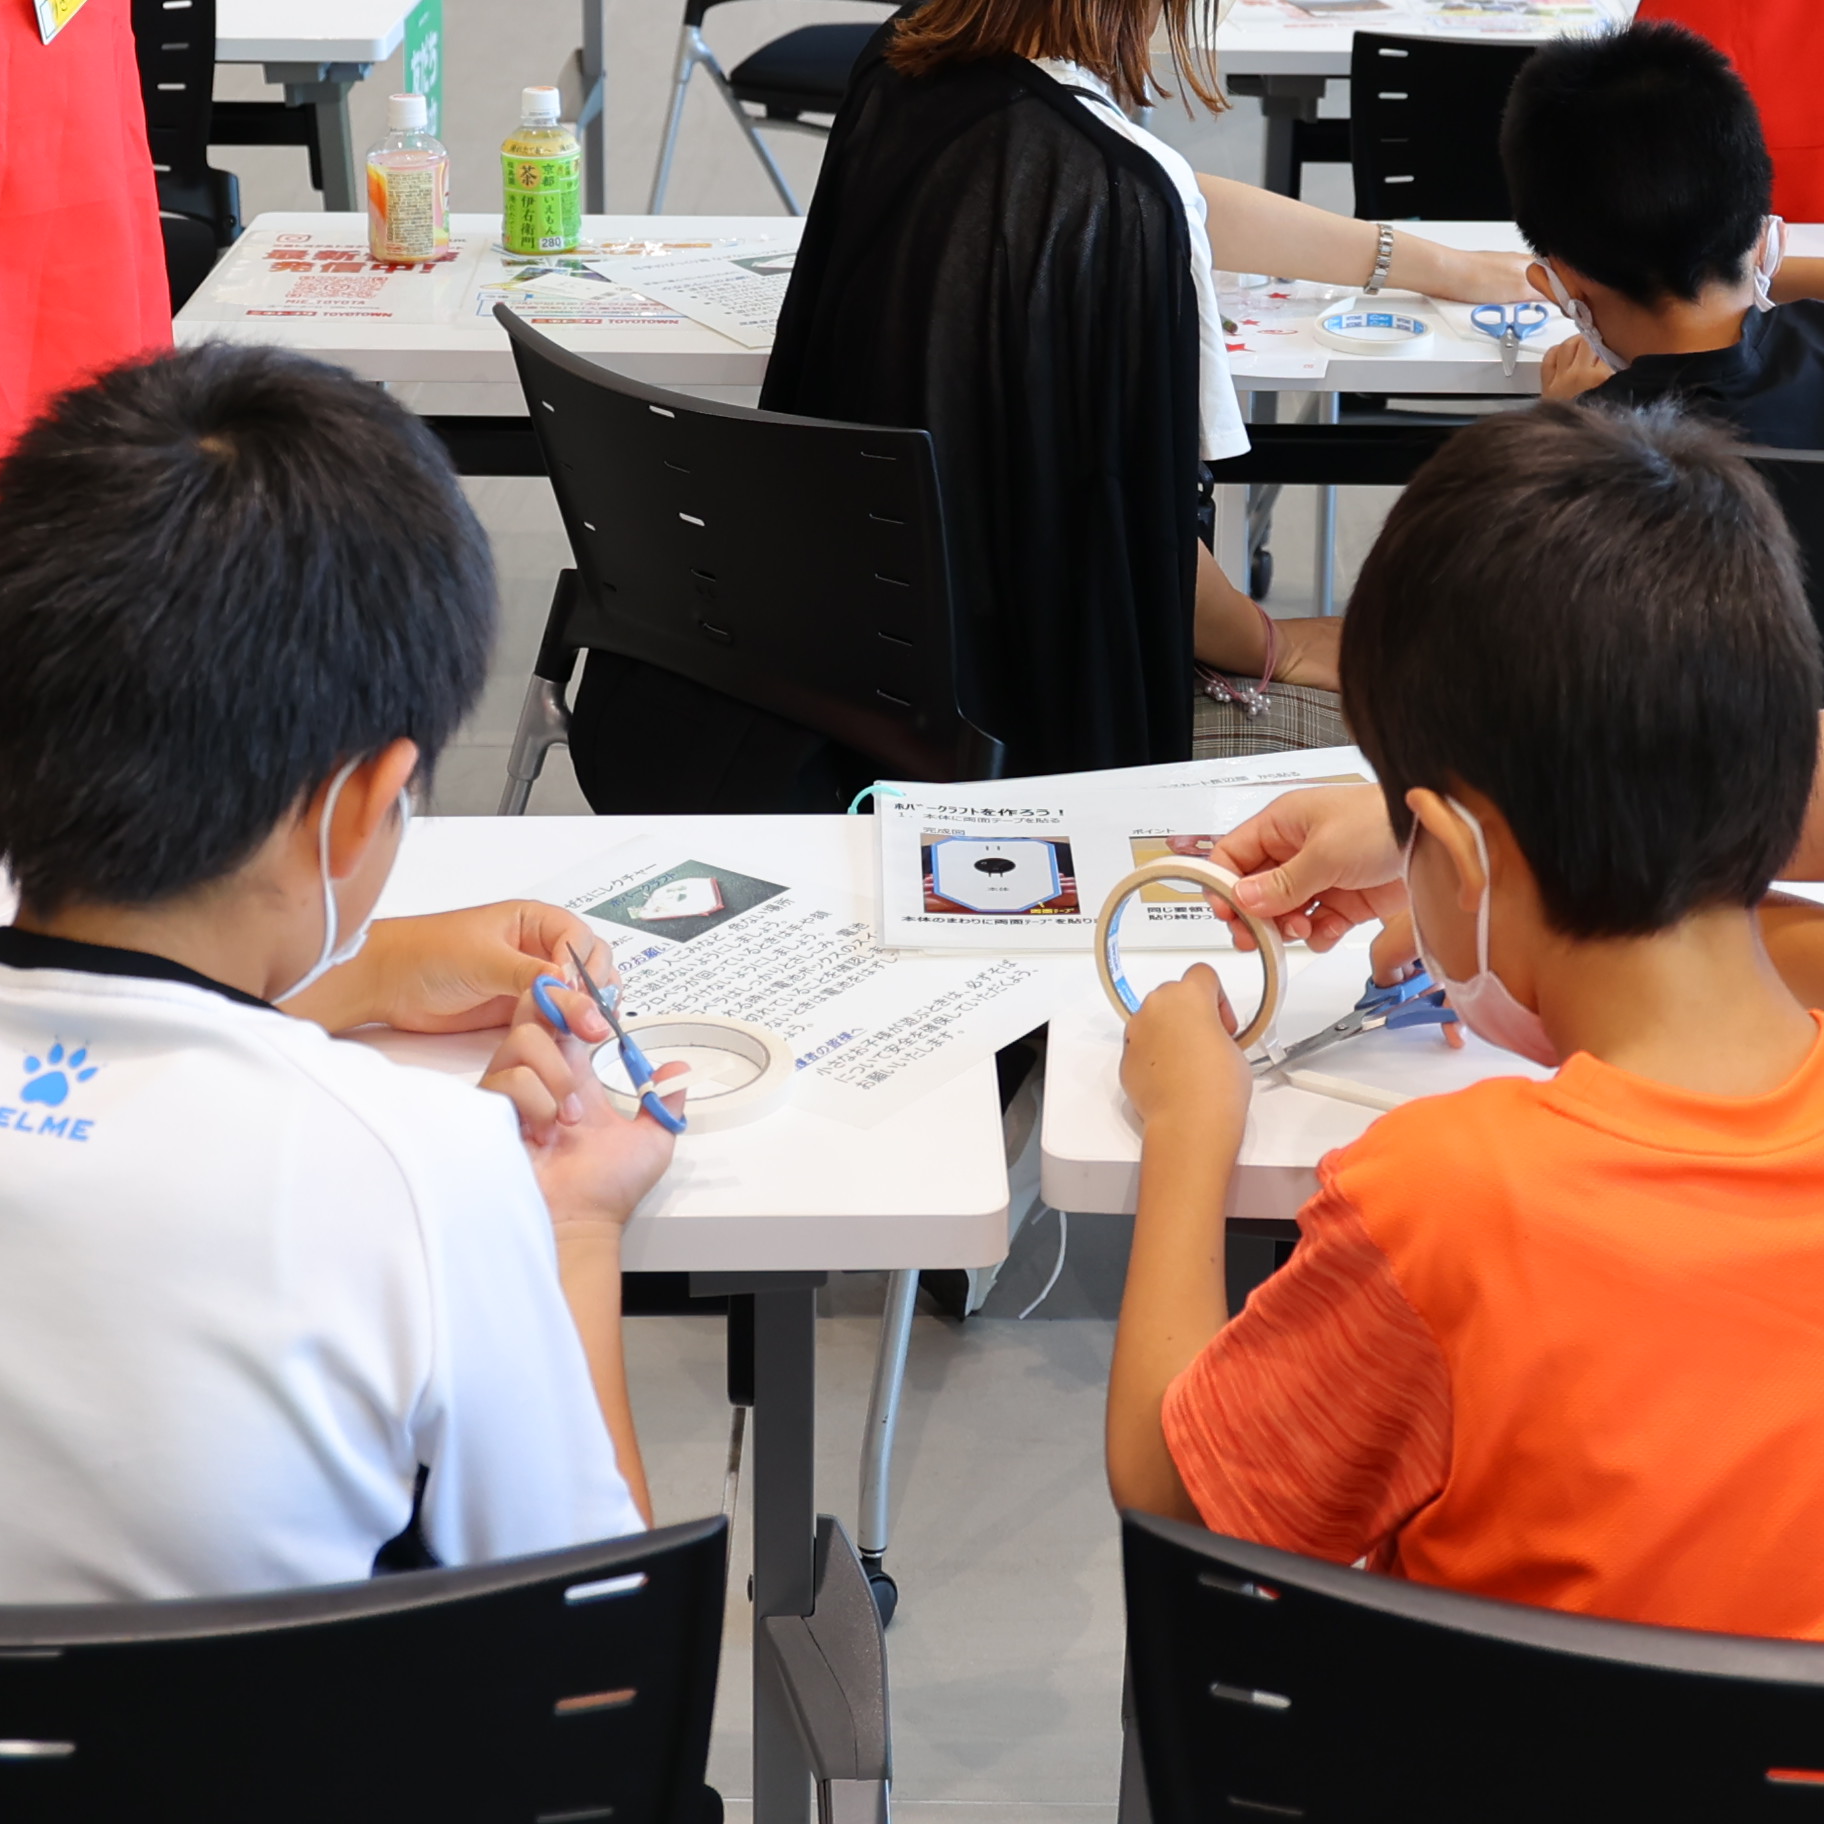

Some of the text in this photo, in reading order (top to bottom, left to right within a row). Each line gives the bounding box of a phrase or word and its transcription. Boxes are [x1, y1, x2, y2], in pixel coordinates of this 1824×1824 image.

[519, 163, 538, 187] 茶
[520, 194, 536, 249] 伊右衛門
[541, 237, 562, 249] 280
[924, 813, 1062, 825] 本体に両面テープを貼る
[922, 826, 967, 837] 完成図
[1132, 827, 1177, 836] ポイント
[900, 915, 1099, 926] 本体のまわりに両面テープを貼り
[1148, 914, 1218, 922] 貼り終わっ
[723, 931, 878, 1018] れる時は電池ボックスのスイ
